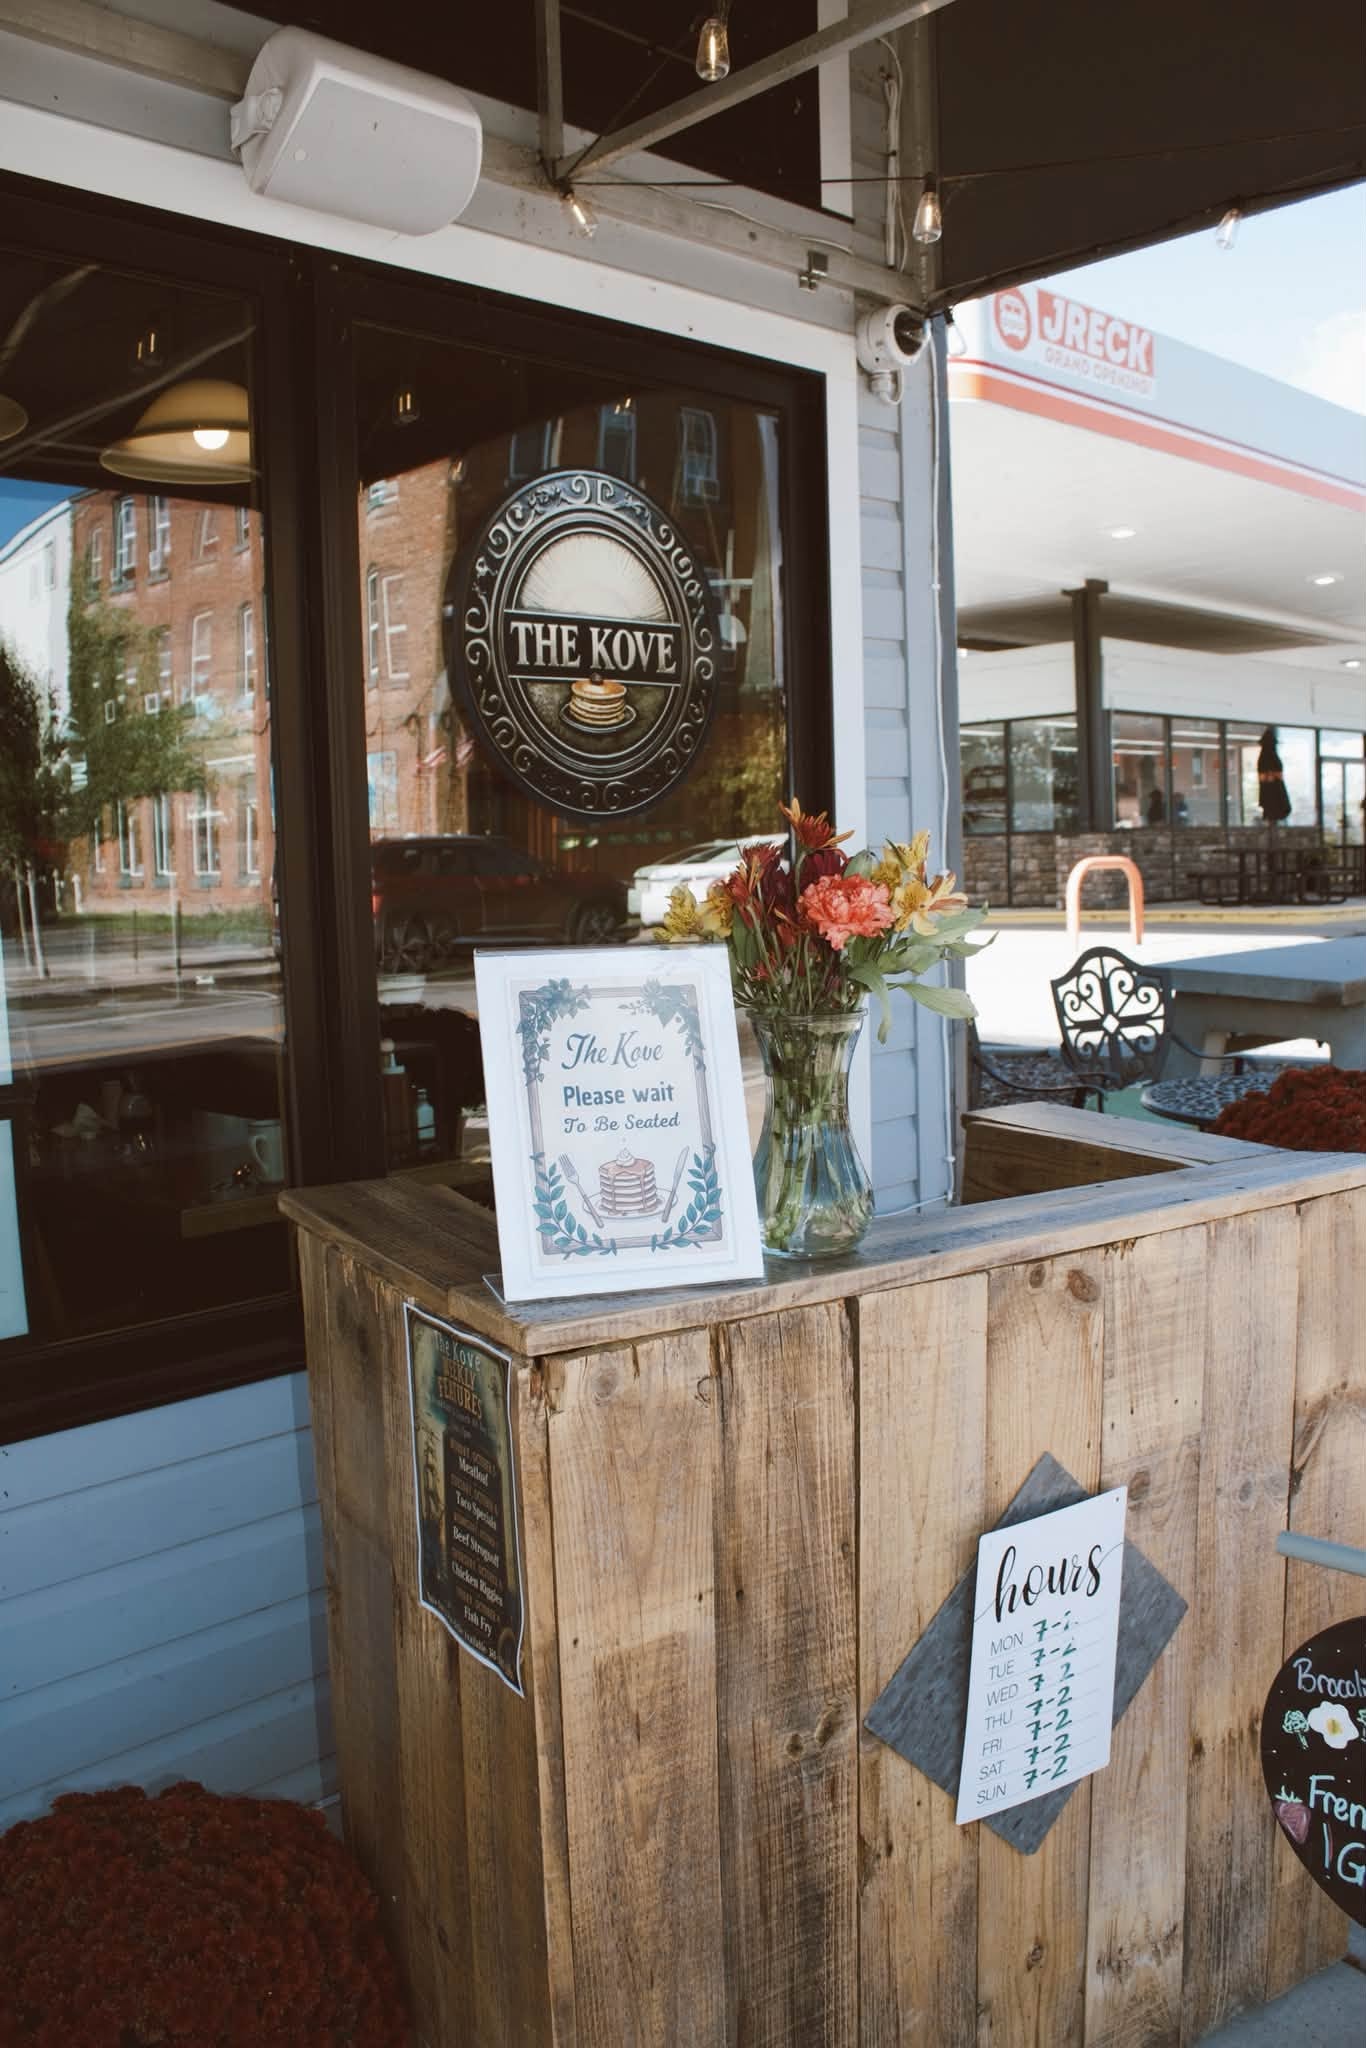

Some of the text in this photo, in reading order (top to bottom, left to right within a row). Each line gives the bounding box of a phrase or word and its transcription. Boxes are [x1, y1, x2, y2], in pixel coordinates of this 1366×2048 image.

[1043, 297, 1151, 374] JRECK
[1045, 347, 1089, 376] GRAND
[509, 620, 678, 675] THE KOVE
[561, 1030, 665, 1070] The Kove
[562, 1081, 675, 1107] Please wait
[563, 1111, 681, 1134] To Be Seated
[432, 1329, 481, 1372] The Kove
[458, 1455, 489, 1488] Meatloaf
[455, 1489, 472, 1513] Taco
[453, 1525, 470, 1547] Beef
[451, 1559, 479, 1590] Chicken
[977, 1543, 1120, 1623] hours
[464, 1605, 480, 1627] Fish
[480, 1615, 492, 1638] Fry
[989, 1631, 1024, 1657] MON
[988, 1659, 1016, 1680] TUE
[984, 1685, 1073, 1731] THU 7-2
[986, 1683, 1019, 1707] WED
[982, 1708, 1073, 1757] FRI 7-2
[979, 1733, 1071, 1781] SAT 7-2
[976, 1755, 1068, 1805] SUN 7-2
